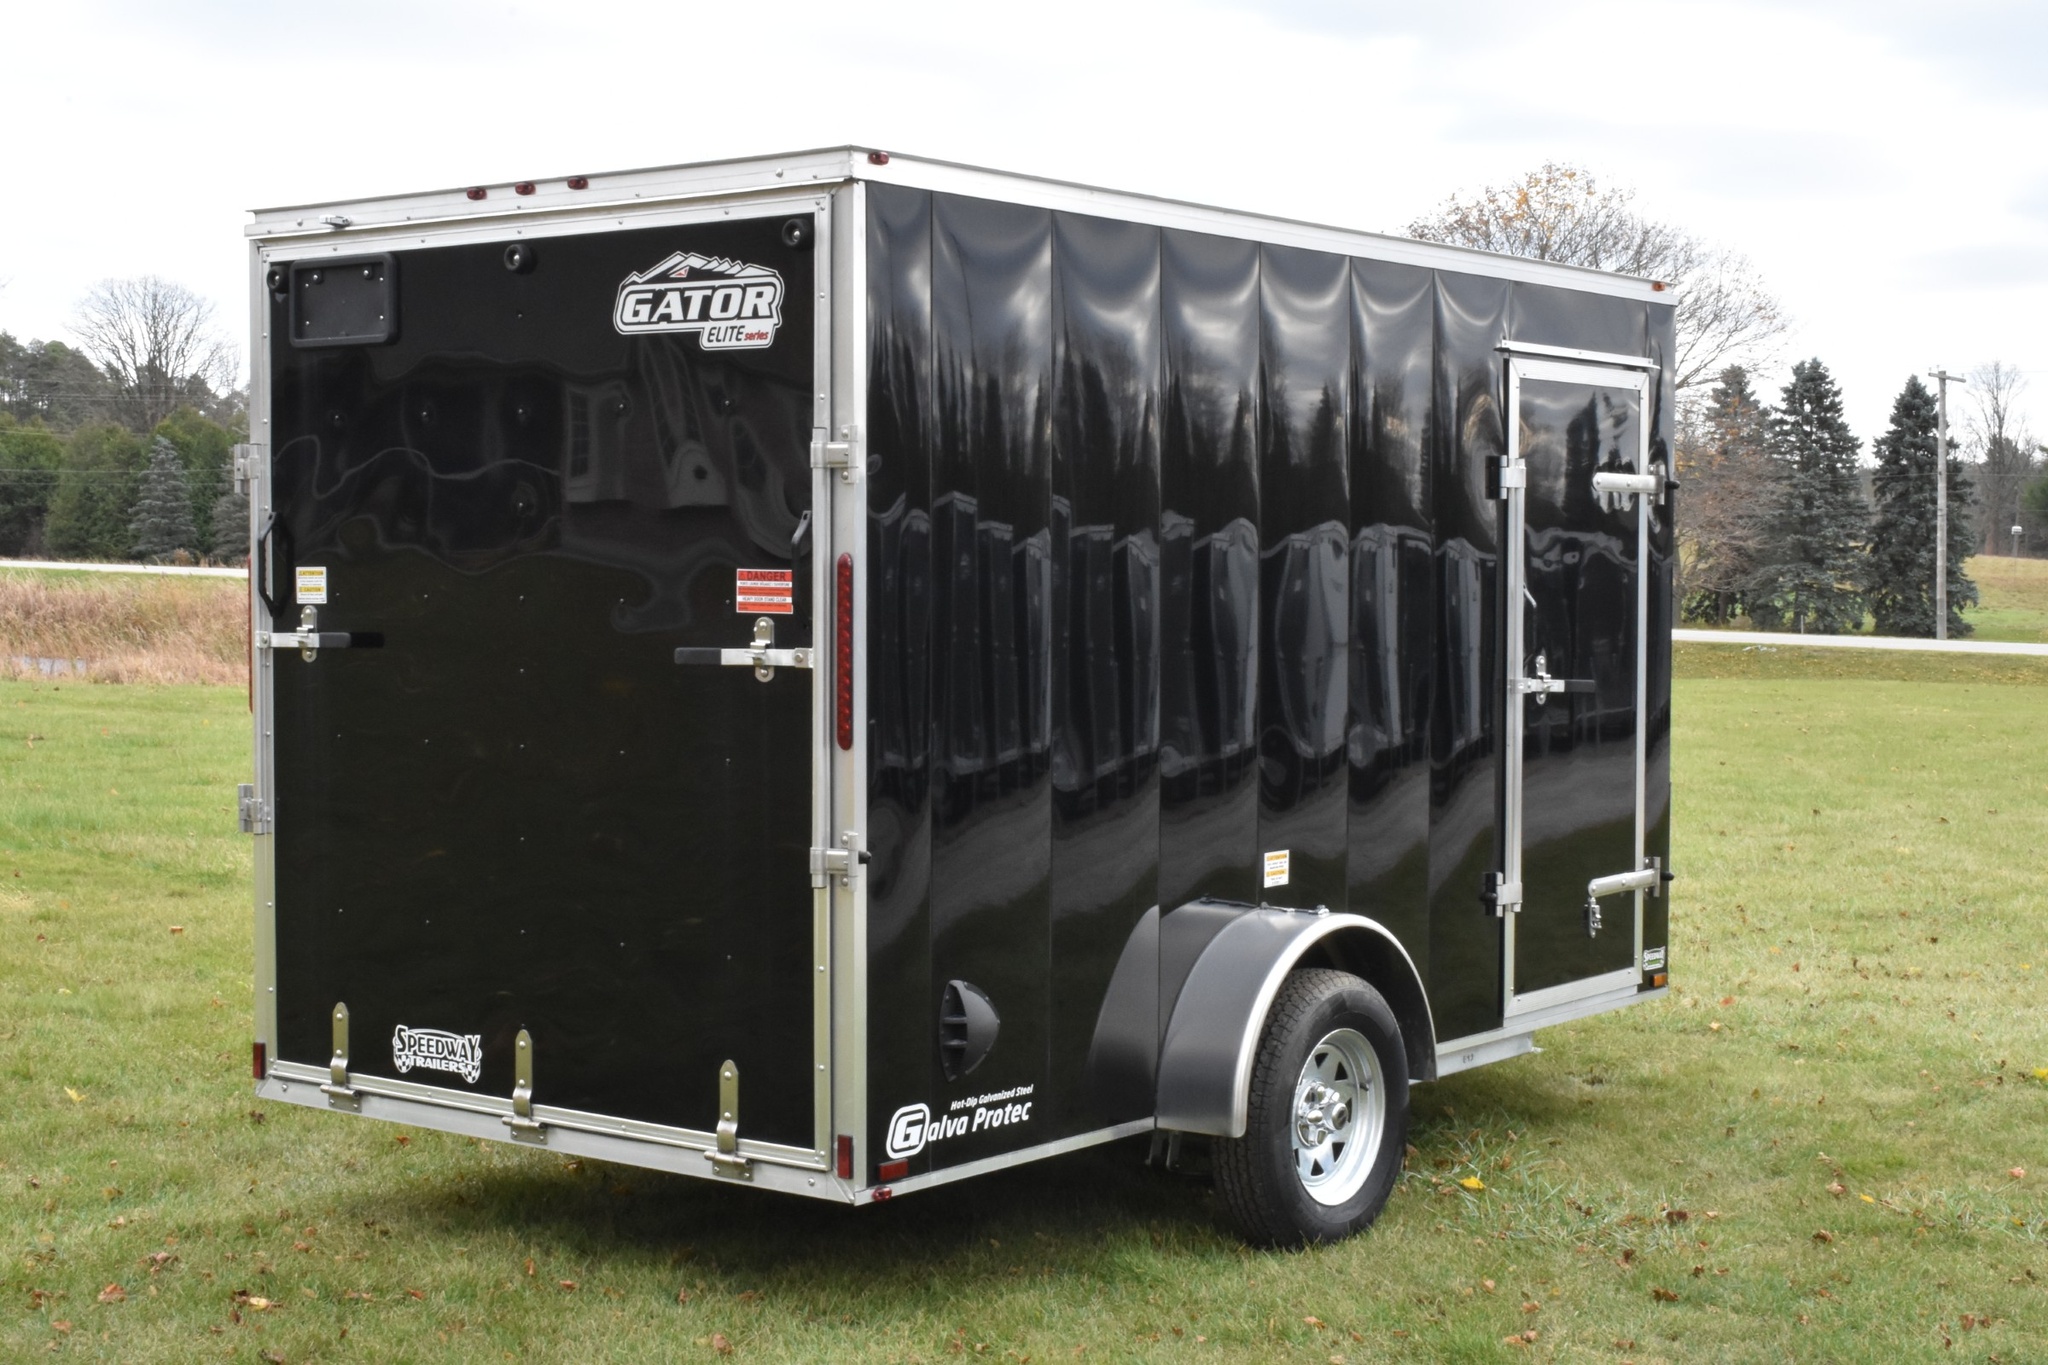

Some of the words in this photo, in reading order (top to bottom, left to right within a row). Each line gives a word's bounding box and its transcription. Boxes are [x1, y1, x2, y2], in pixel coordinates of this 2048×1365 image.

[621, 285, 775, 324] GATOR
[707, 325, 746, 343] ELITE
[744, 329, 769, 341] series
[746, 571, 786, 581] DANGER
[395, 1024, 480, 1066] SPEEDWAY
[408, 1055, 466, 1073] TRAILERS
[950, 1096, 978, 1111] Hot-Dip
[978, 1087, 1015, 1104] Galvanized
[1016, 1083, 1034, 1097] Steel
[887, 1103, 969, 1159] Galva
[971, 1101, 1032, 1132] Protec
